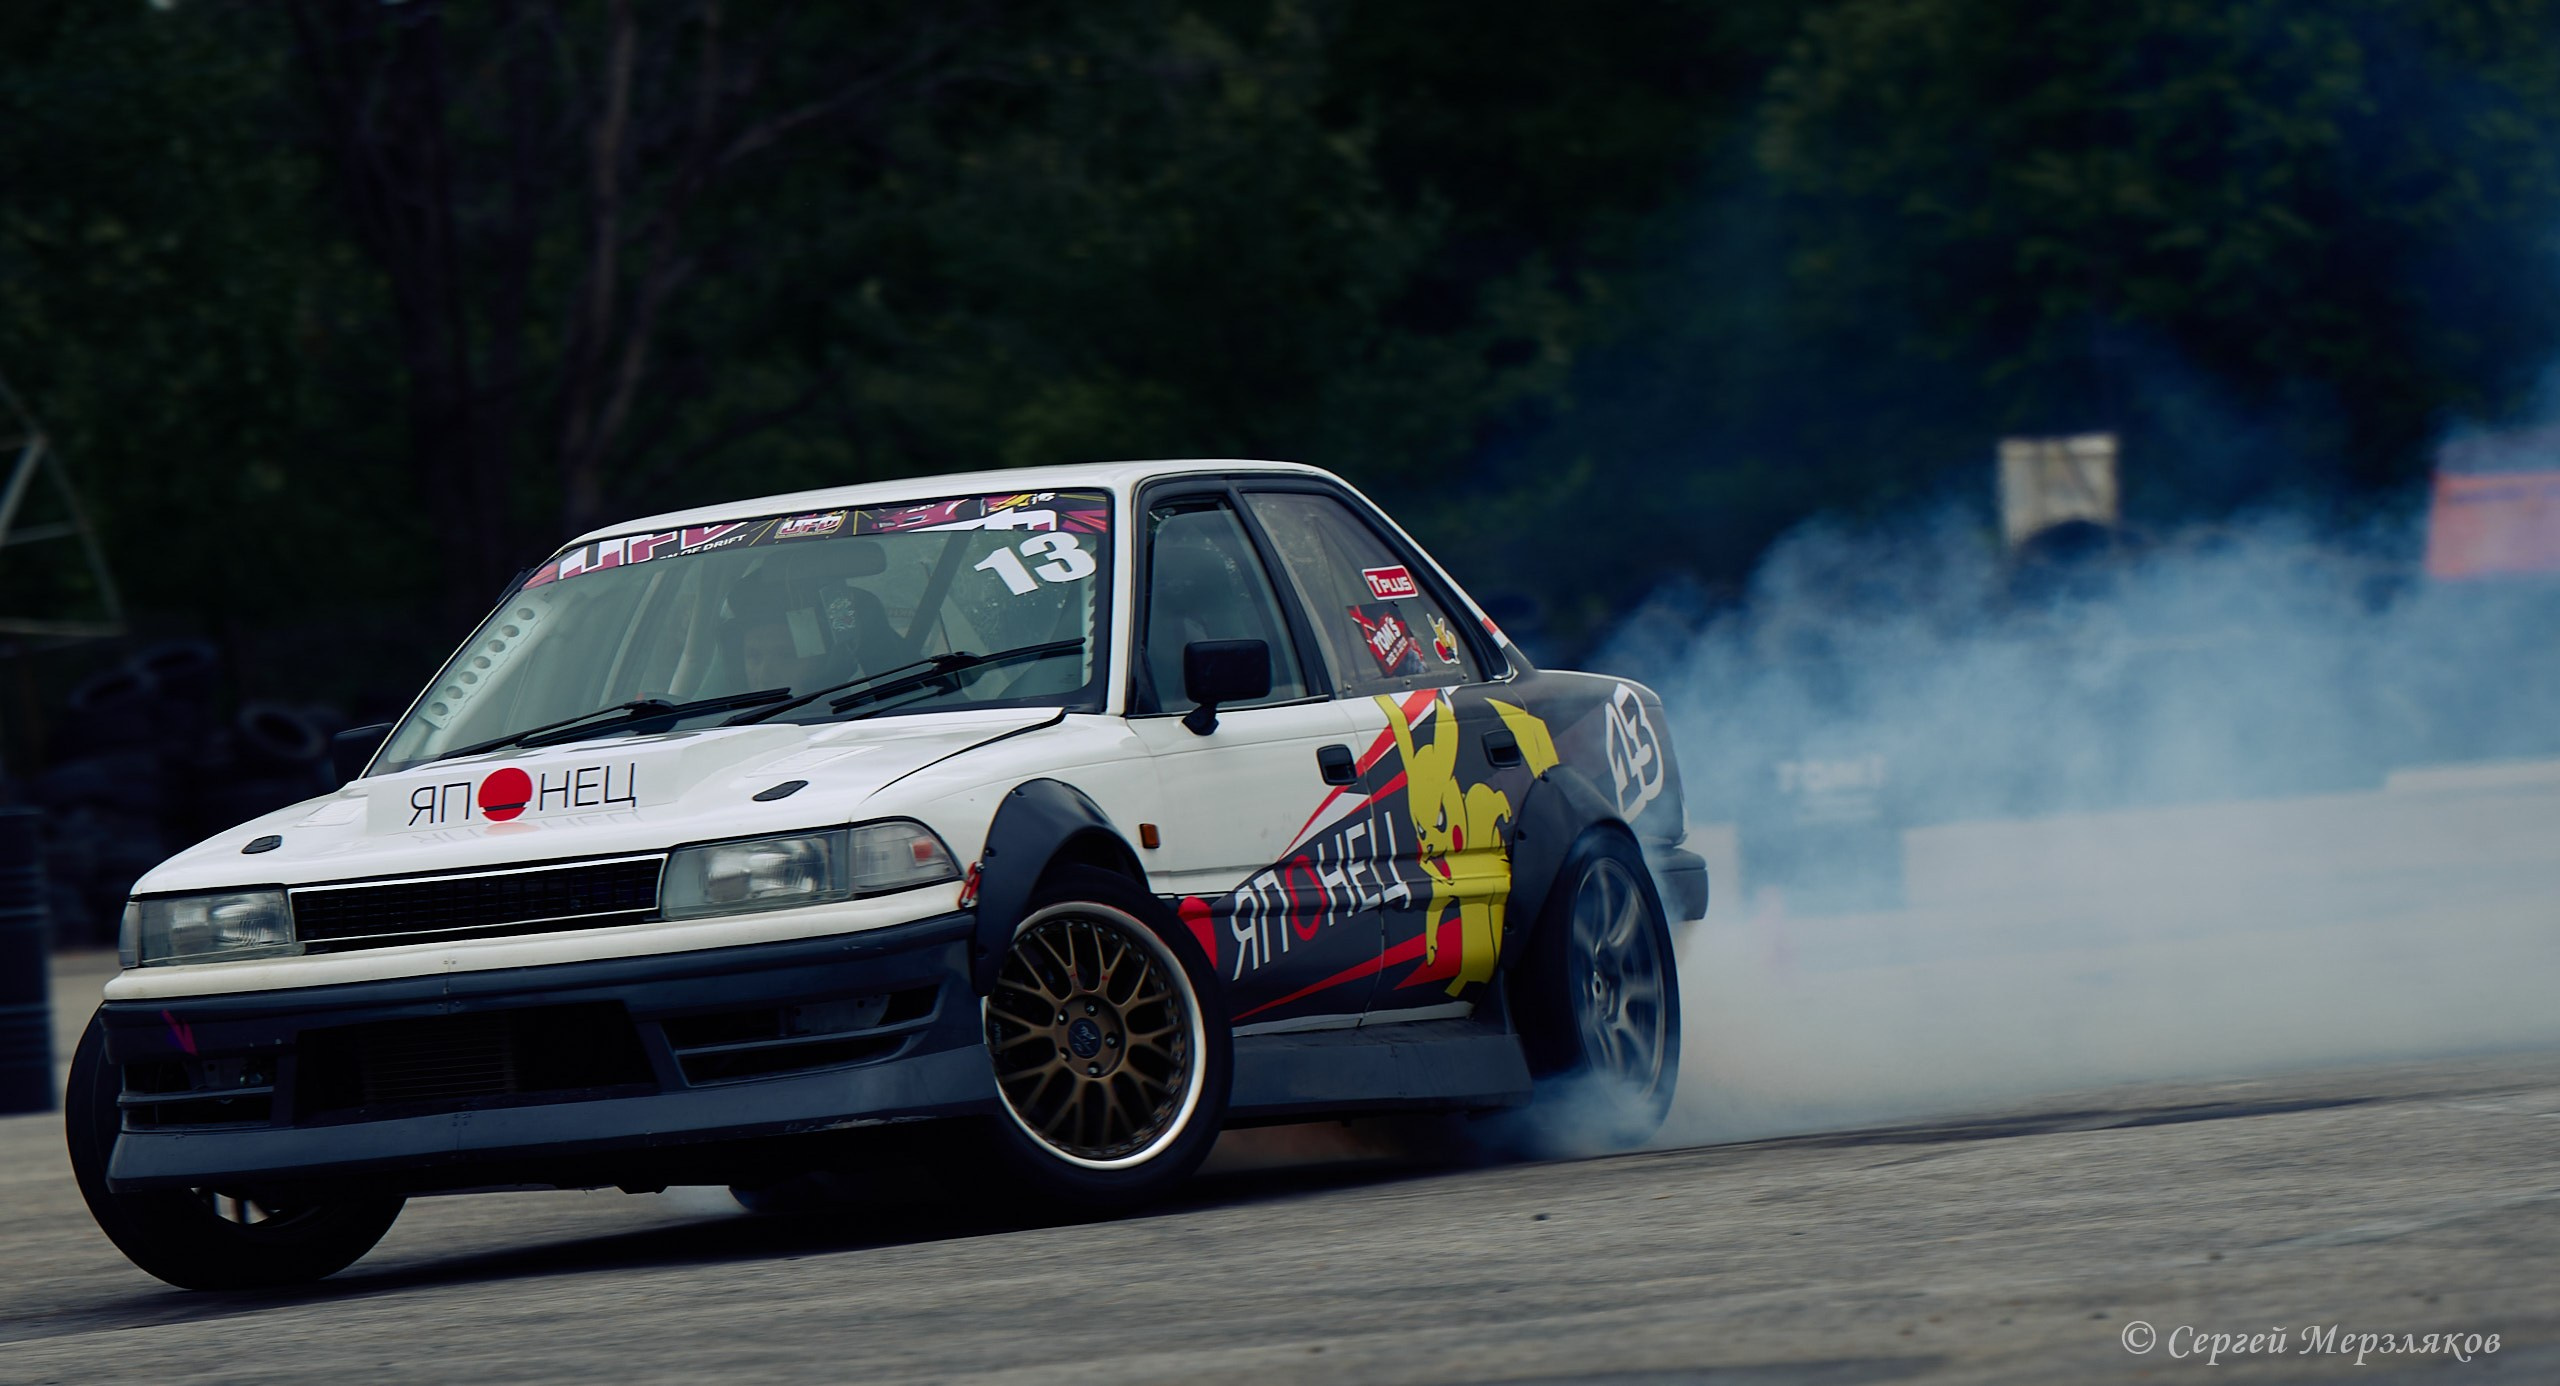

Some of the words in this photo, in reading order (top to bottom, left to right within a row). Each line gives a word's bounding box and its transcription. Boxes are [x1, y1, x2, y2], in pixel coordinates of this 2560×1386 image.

[702, 534, 747, 551] DRIFT
[973, 531, 1096, 596] 13
[1372, 616, 1402, 656] TOM'S
[408, 762, 637, 826] ЯПОНЕЦ
[1229, 810, 1412, 981] ЯПОНЕЦ
